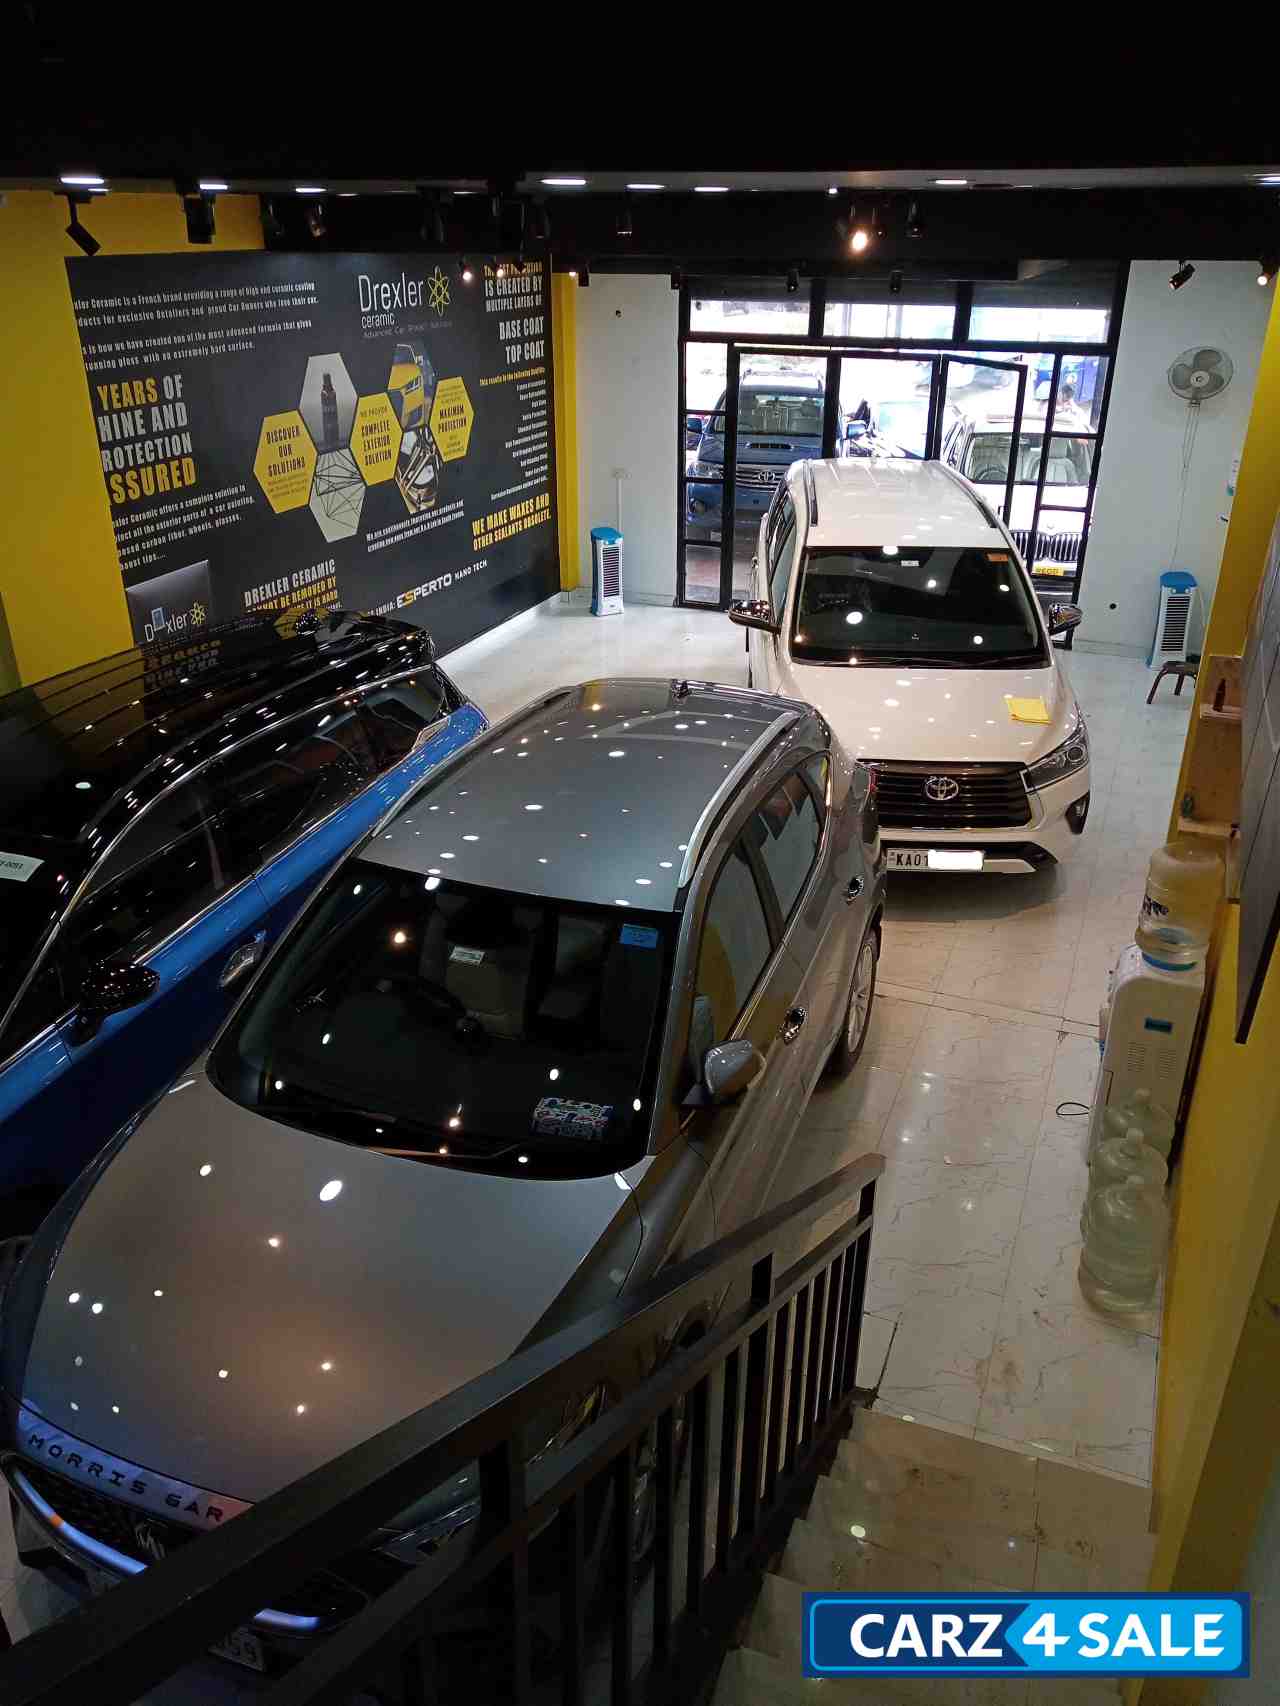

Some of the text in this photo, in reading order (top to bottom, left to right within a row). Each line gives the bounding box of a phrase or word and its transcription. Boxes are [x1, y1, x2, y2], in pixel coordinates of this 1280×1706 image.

[358, 271, 424, 312] Drexler
[485, 275, 543, 297] IS CREATED BY
[91, 297, 122, 309] Ceramic
[138, 293, 161, 305] French
[162, 291, 182, 304] brand
[104, 314, 115, 324] for
[117, 311, 154, 324] exclusive
[156, 308, 190, 320] Detailers
[191, 306, 204, 316] and
[228, 303, 239, 312] Car
[241, 300, 263, 312] Owners
[486, 297, 513, 313] MULTIPLE
[361, 310, 395, 329] ceramic
[523, 316, 544, 337] COAT
[97, 342, 113, 354] how
[114, 341, 125, 351] we
[126, 339, 144, 350] have
[145, 336, 172, 348] created
[194, 331, 206, 342] the
[208, 329, 225, 340] most
[226, 325, 257, 338] advanced
[143, 352, 160, 363] with
[173, 345, 209, 360] extremely
[210, 342, 226, 354] hard
[506, 340, 545, 365] TOP COAT
[97, 374, 183, 411] YEARS OF
[98, 402, 188, 442] HINE AND
[361, 419, 390, 439] COMPLETE
[266, 424, 300, 445] DISCOVER
[363, 435, 391, 451] EXTERIOR
[101, 431, 193, 473] ROTECTION
[278, 443, 292, 458] OUR
[365, 450, 392, 466] SOLUTION
[268, 457, 306, 477] SOLUTIONS
[110, 457, 196, 504] SSURED
[130, 509, 158, 523] Ceramic
[159, 502, 178, 514] offers
[185, 494, 214, 507] complete
[214, 487, 239, 500] solution
[472, 516, 485, 537] WE
[486, 509, 507, 530] MAKE
[535, 492, 550, 511] AND
[144, 522, 155, 535] the
[156, 516, 181, 530] exterior
[182, 511, 200, 524] parts
[141, 535, 167, 550] carbon
[473, 531, 493, 552] OTHER
[494, 519, 523, 542] SEALANTS
[244, 577, 290, 607] DREXLER
[292, 559, 336, 587] CERAMIC
[280, 594, 291, 608] BE
[291, 579, 327, 603] REMOVED
[326, 575, 337, 589] BY
[396, 572, 452, 609] ESPERTO
[454, 566, 472, 580] NANO
[473, 559, 488, 572] TECH
[144, 610, 188, 642] Dxler
[28, 1433, 225, 1523] MORRIS GAR
